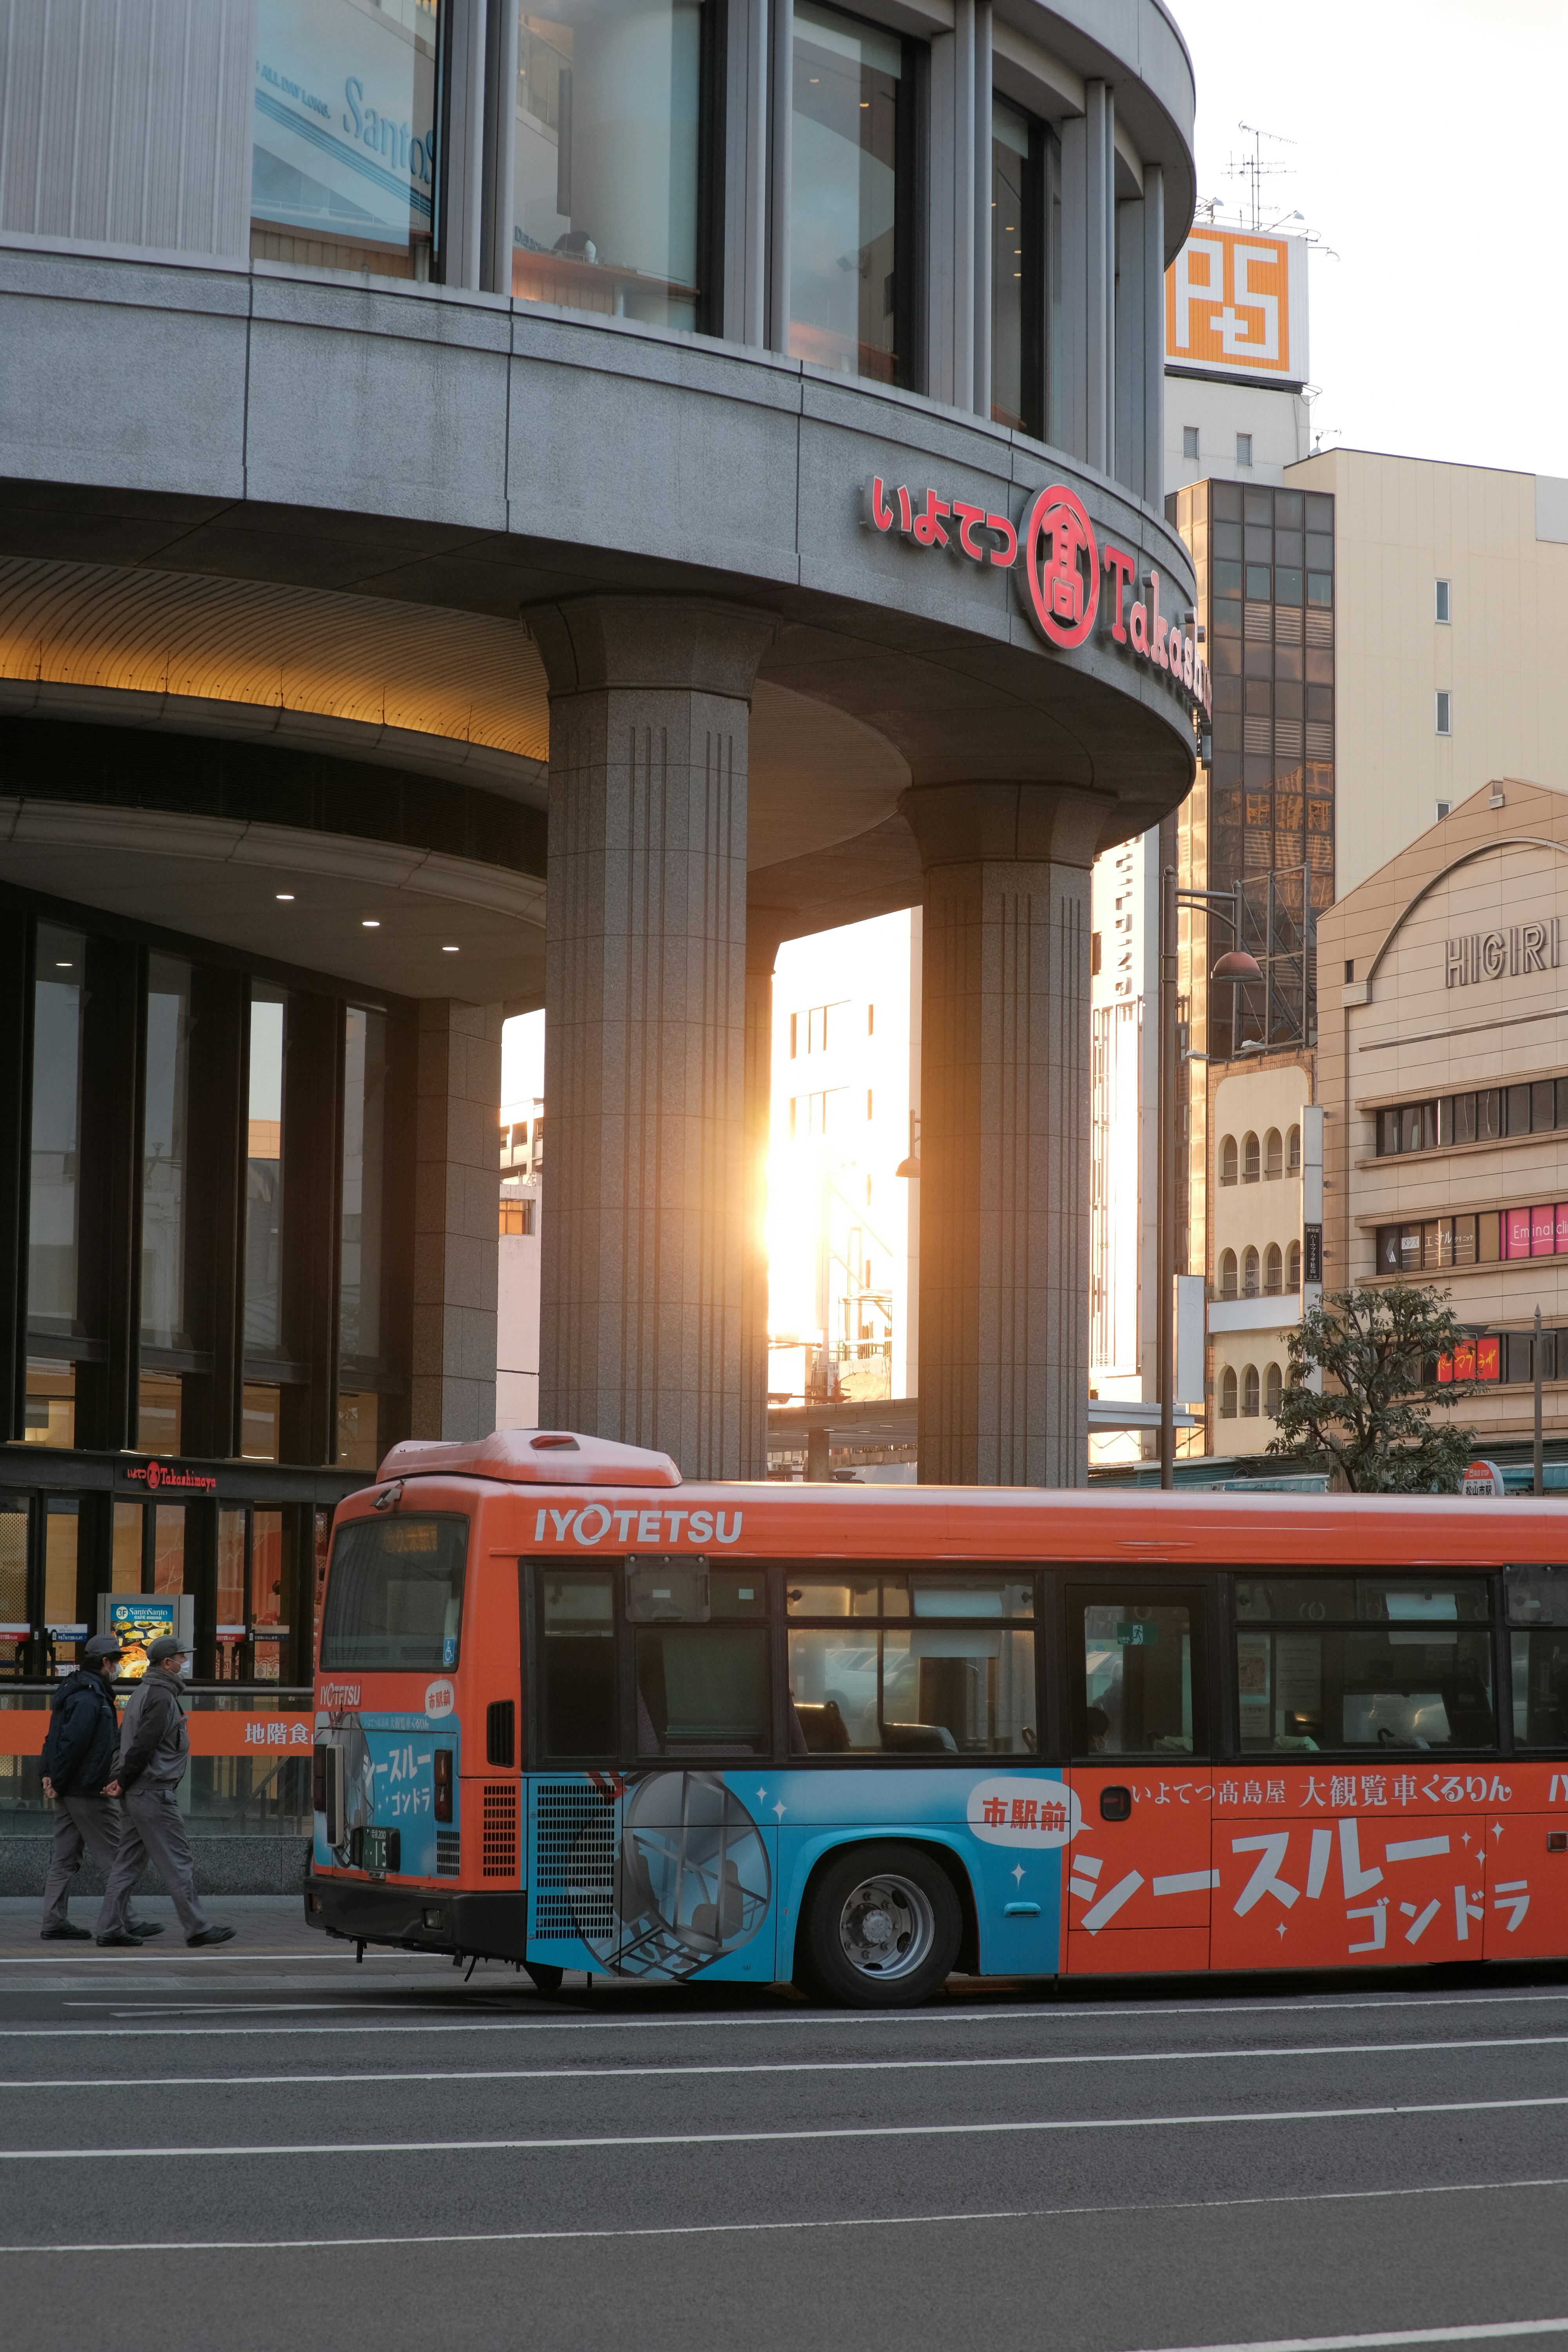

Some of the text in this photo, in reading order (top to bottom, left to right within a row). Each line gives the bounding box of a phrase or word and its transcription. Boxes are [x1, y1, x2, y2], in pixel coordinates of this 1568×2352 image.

[867, 475, 1018, 567] いよてつ
[1116, 832, 1143, 996] UILDING
[1445, 918, 1560, 988] HIGIRI
[1403, 1231, 1473, 1248] メンズ エミナル クリニック
[1514, 1220, 1568, 1239] Eminal cli
[160, 1468, 216, 1492] Takashimaya
[1466, 1485, 1492, 1495] 松山市駅
[534, 1504, 743, 1546] IYOTETSU
[118, 1608, 168, 1617] 3F SantoSanto
[320, 1682, 361, 1708] IYOTETSU
[428, 1689, 450, 1710] 市駅前
[245, 1723, 314, 1745] 地階食
[363, 1744, 431, 1788] シースルー
[391, 1788, 430, 1817] ゴンドラ
[982, 1797, 1067, 1832] 市駅前
[1067, 1817, 1450, 1936] シースルー
[1346, 1880, 1530, 1954] ゴンドラ
